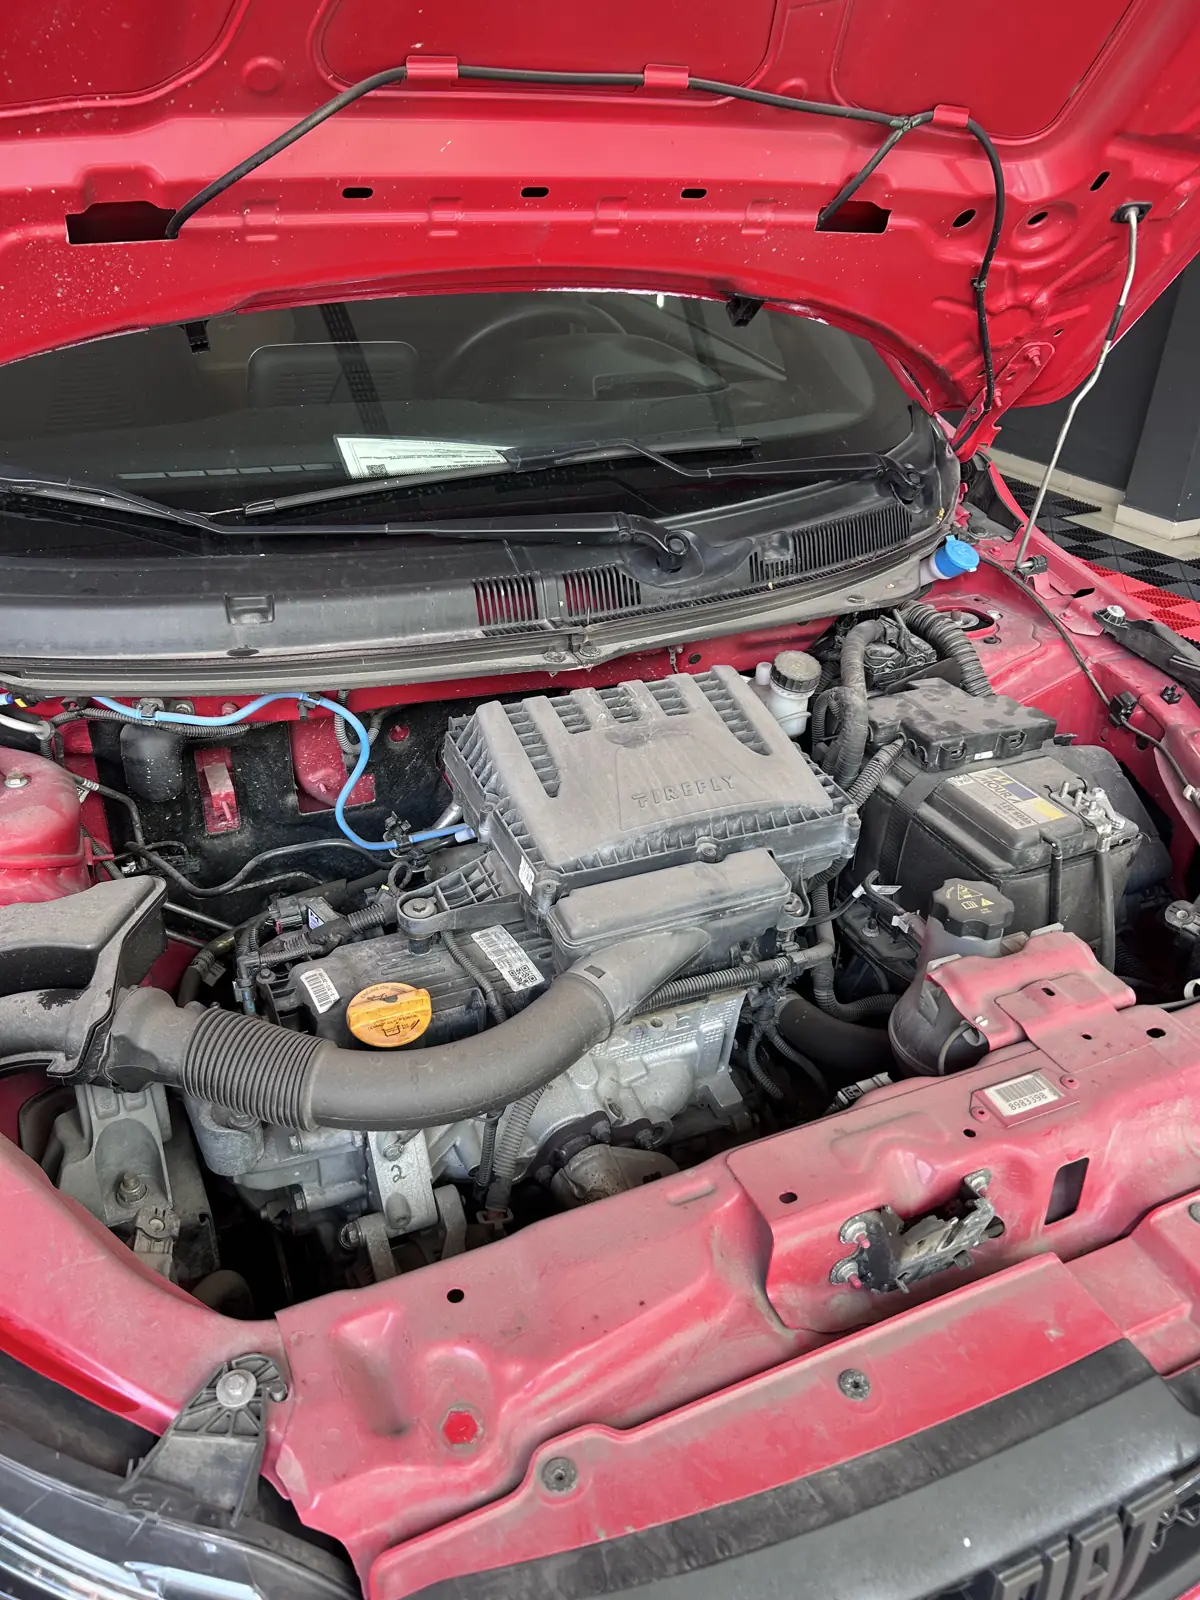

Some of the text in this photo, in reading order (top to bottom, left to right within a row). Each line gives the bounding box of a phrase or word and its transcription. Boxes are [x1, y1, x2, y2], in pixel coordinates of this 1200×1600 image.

[631, 775, 735, 808] FIREFLY
[974, 776, 1021, 804] MOURA
[1008, 1092, 1048, 1111] 8983398
[391, 1165, 411, 1183] 2
